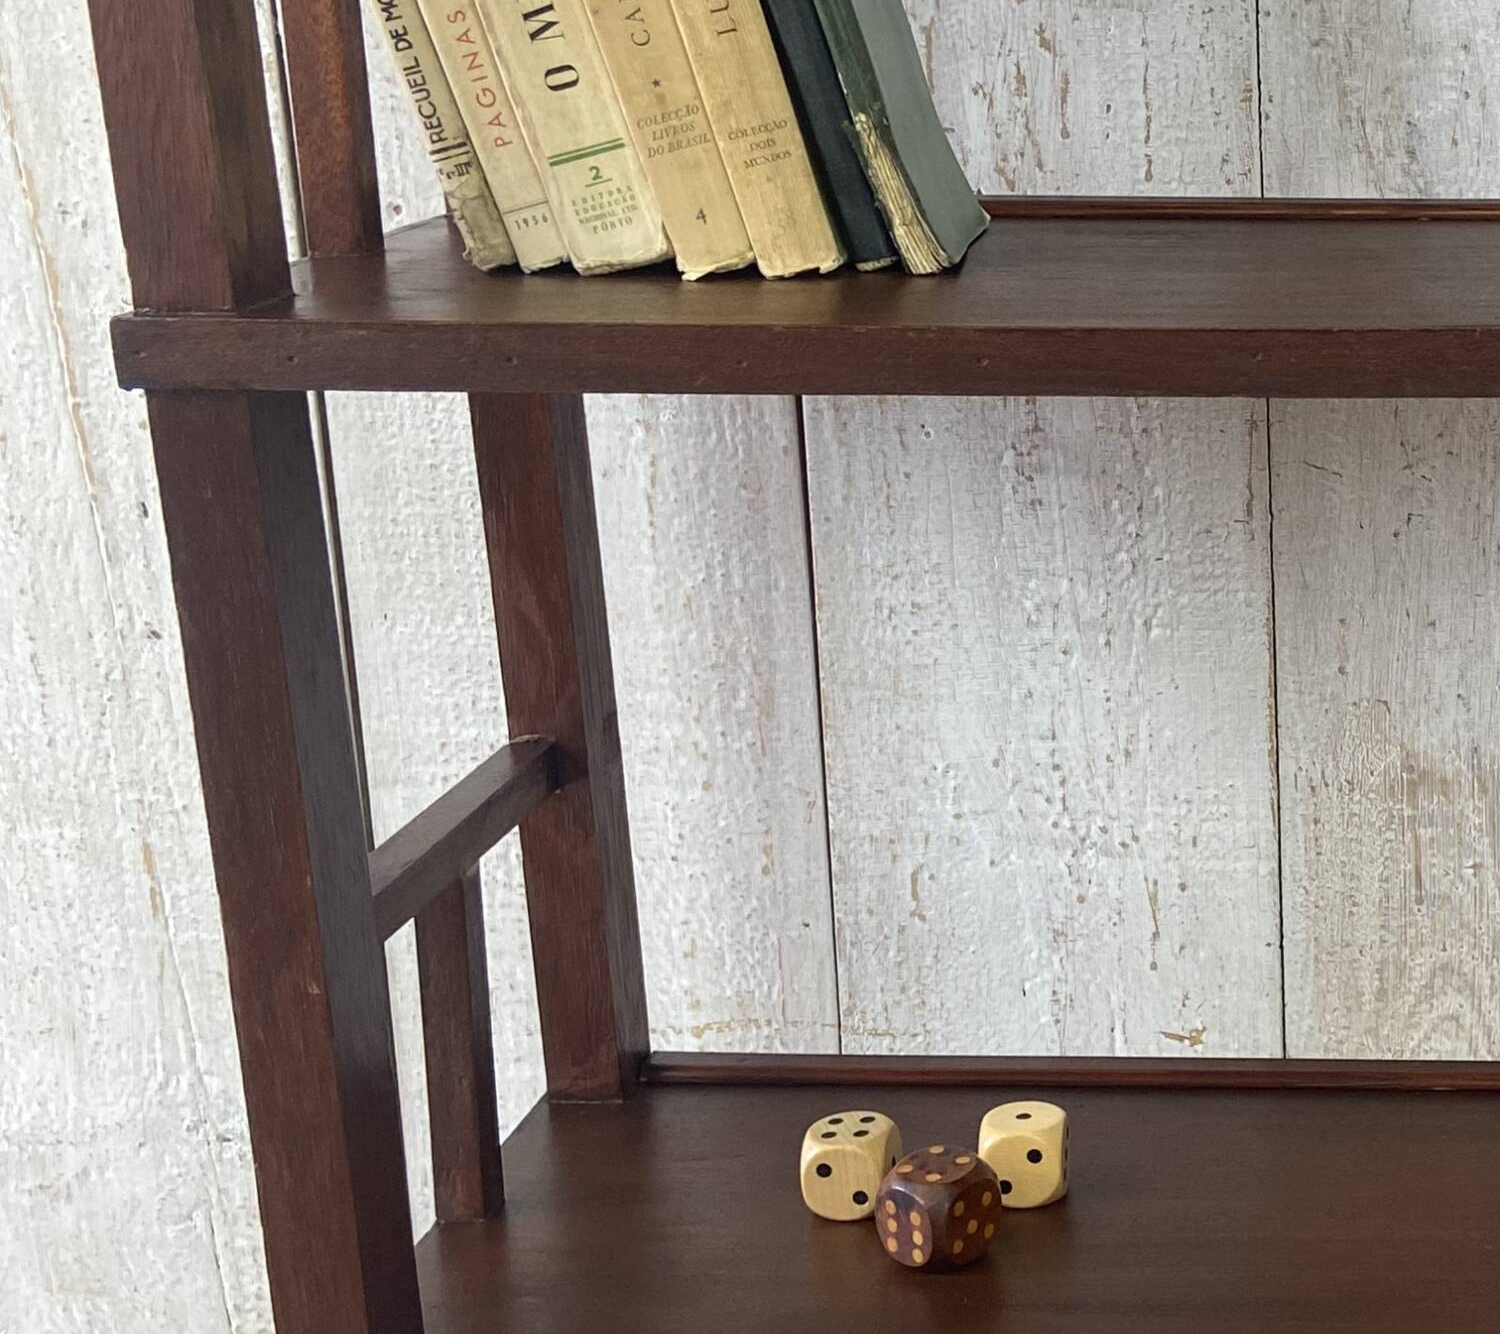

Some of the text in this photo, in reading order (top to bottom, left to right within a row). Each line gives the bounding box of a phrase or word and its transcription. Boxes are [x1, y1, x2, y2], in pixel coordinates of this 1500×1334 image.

[389, 25, 412, 52] DE
[544, 64, 580, 92] O
[403, 56, 448, 145] RECUEIL
[651, 121, 696, 142] LIVROS
[648, 133, 711, 159] DO BRASIL
[750, 140, 777, 152] DOIS
[743, 150, 792, 169] MUNDOS
[589, 166, 603, 180] 2
[593, 216, 633, 235] PORTO
[695, 208, 707, 224] 4
